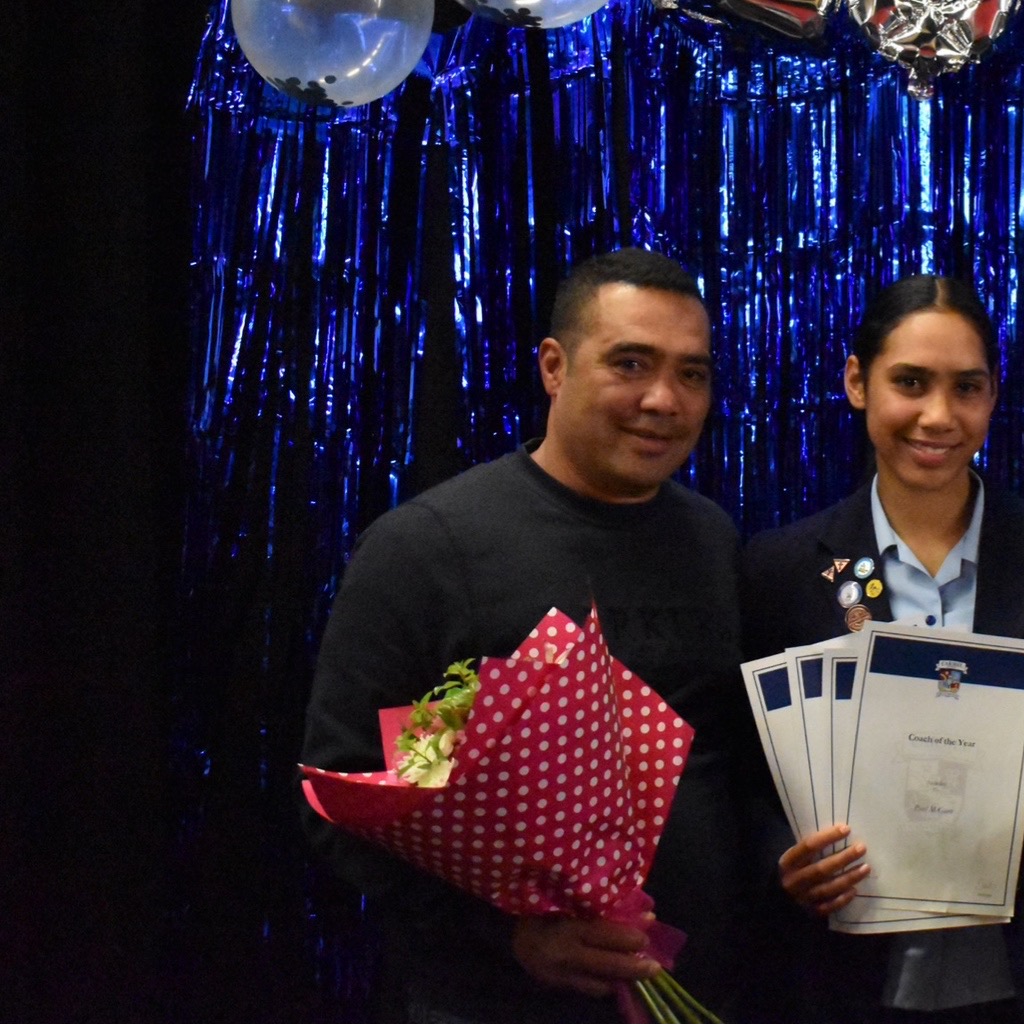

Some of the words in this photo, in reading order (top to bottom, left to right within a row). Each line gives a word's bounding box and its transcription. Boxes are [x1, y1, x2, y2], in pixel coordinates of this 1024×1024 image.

[908, 733, 933, 743] Coach
[944, 738, 956, 746] the
[958, 738, 975, 747] Year
